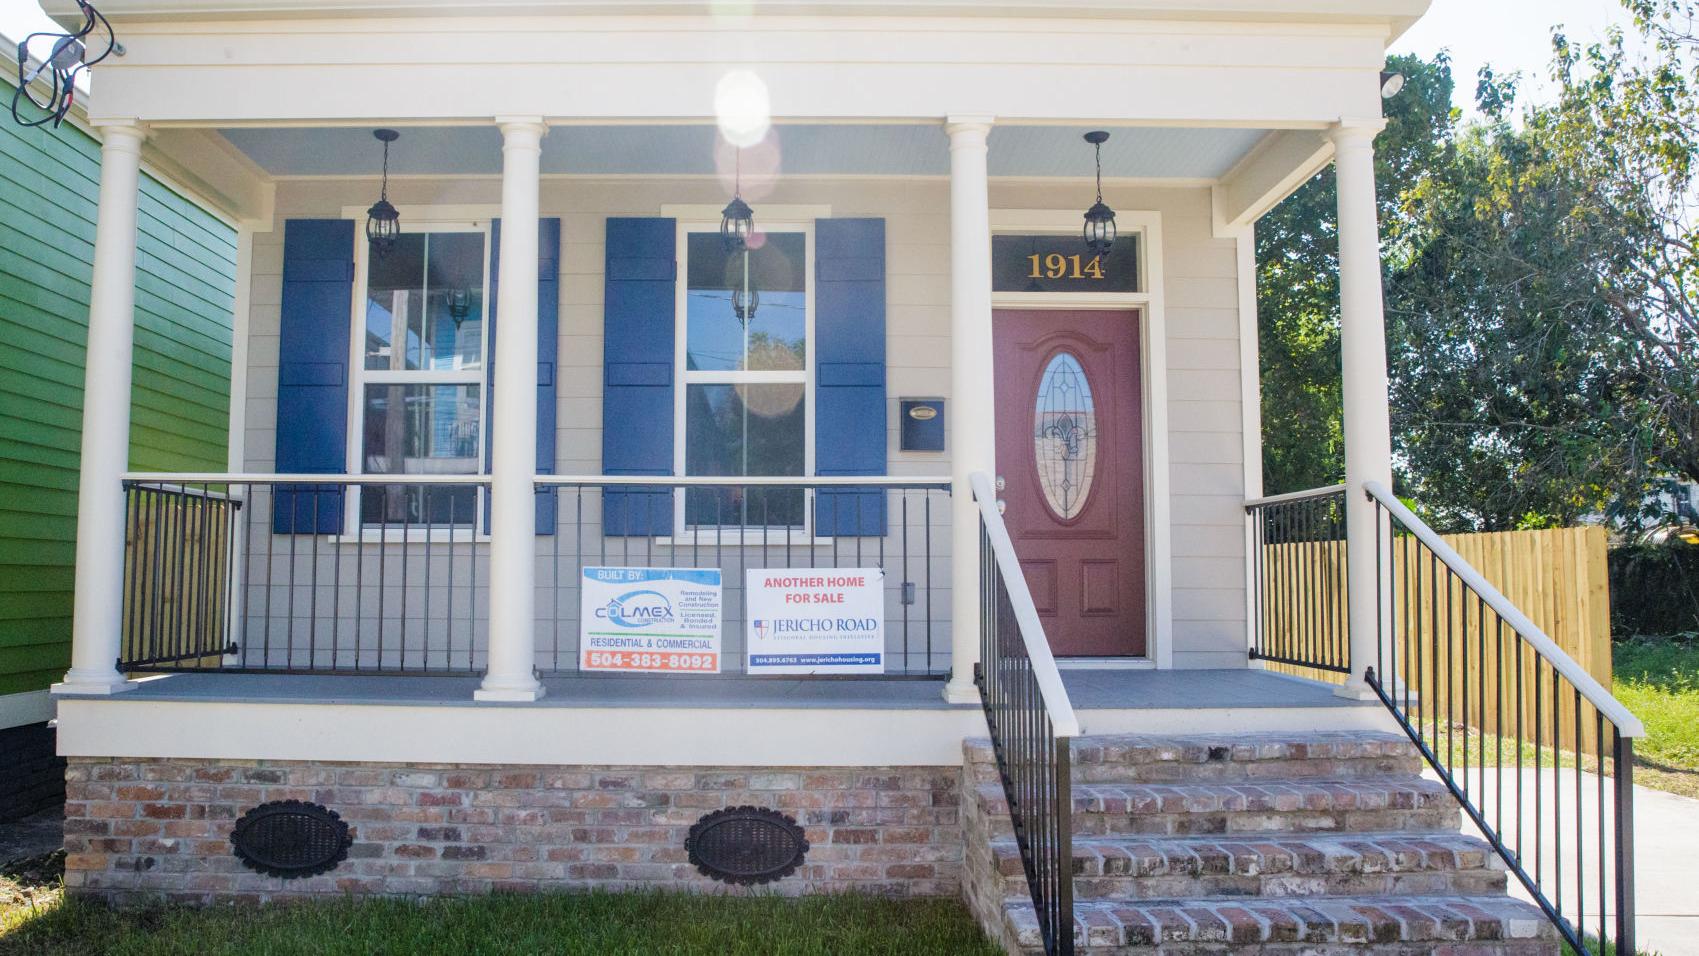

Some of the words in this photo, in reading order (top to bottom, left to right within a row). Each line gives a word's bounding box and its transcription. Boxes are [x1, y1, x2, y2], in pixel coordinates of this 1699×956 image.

[1026, 253, 1106, 279] 1914
[597, 570, 624, 580] BUILT
[628, 570, 644, 580] BY:
[764, 577, 824, 588] ANOTHER
[827, 577, 865, 587] HOME
[785, 593, 811, 604] FOR
[813, 593, 845, 603] SALE
[595, 602, 674, 618] COLMEX
[773, 618, 833, 633] JERICHO
[836, 618, 877, 631] ROAD
[590, 637, 644, 648] RESIDENTIAL
[647, 639, 653, 648] &
[656, 638, 712, 649] COMMERCIAL
[591, 653, 713, 668] 504-383-8092
[800, 656, 875, 664] www.jerichohousing.org
